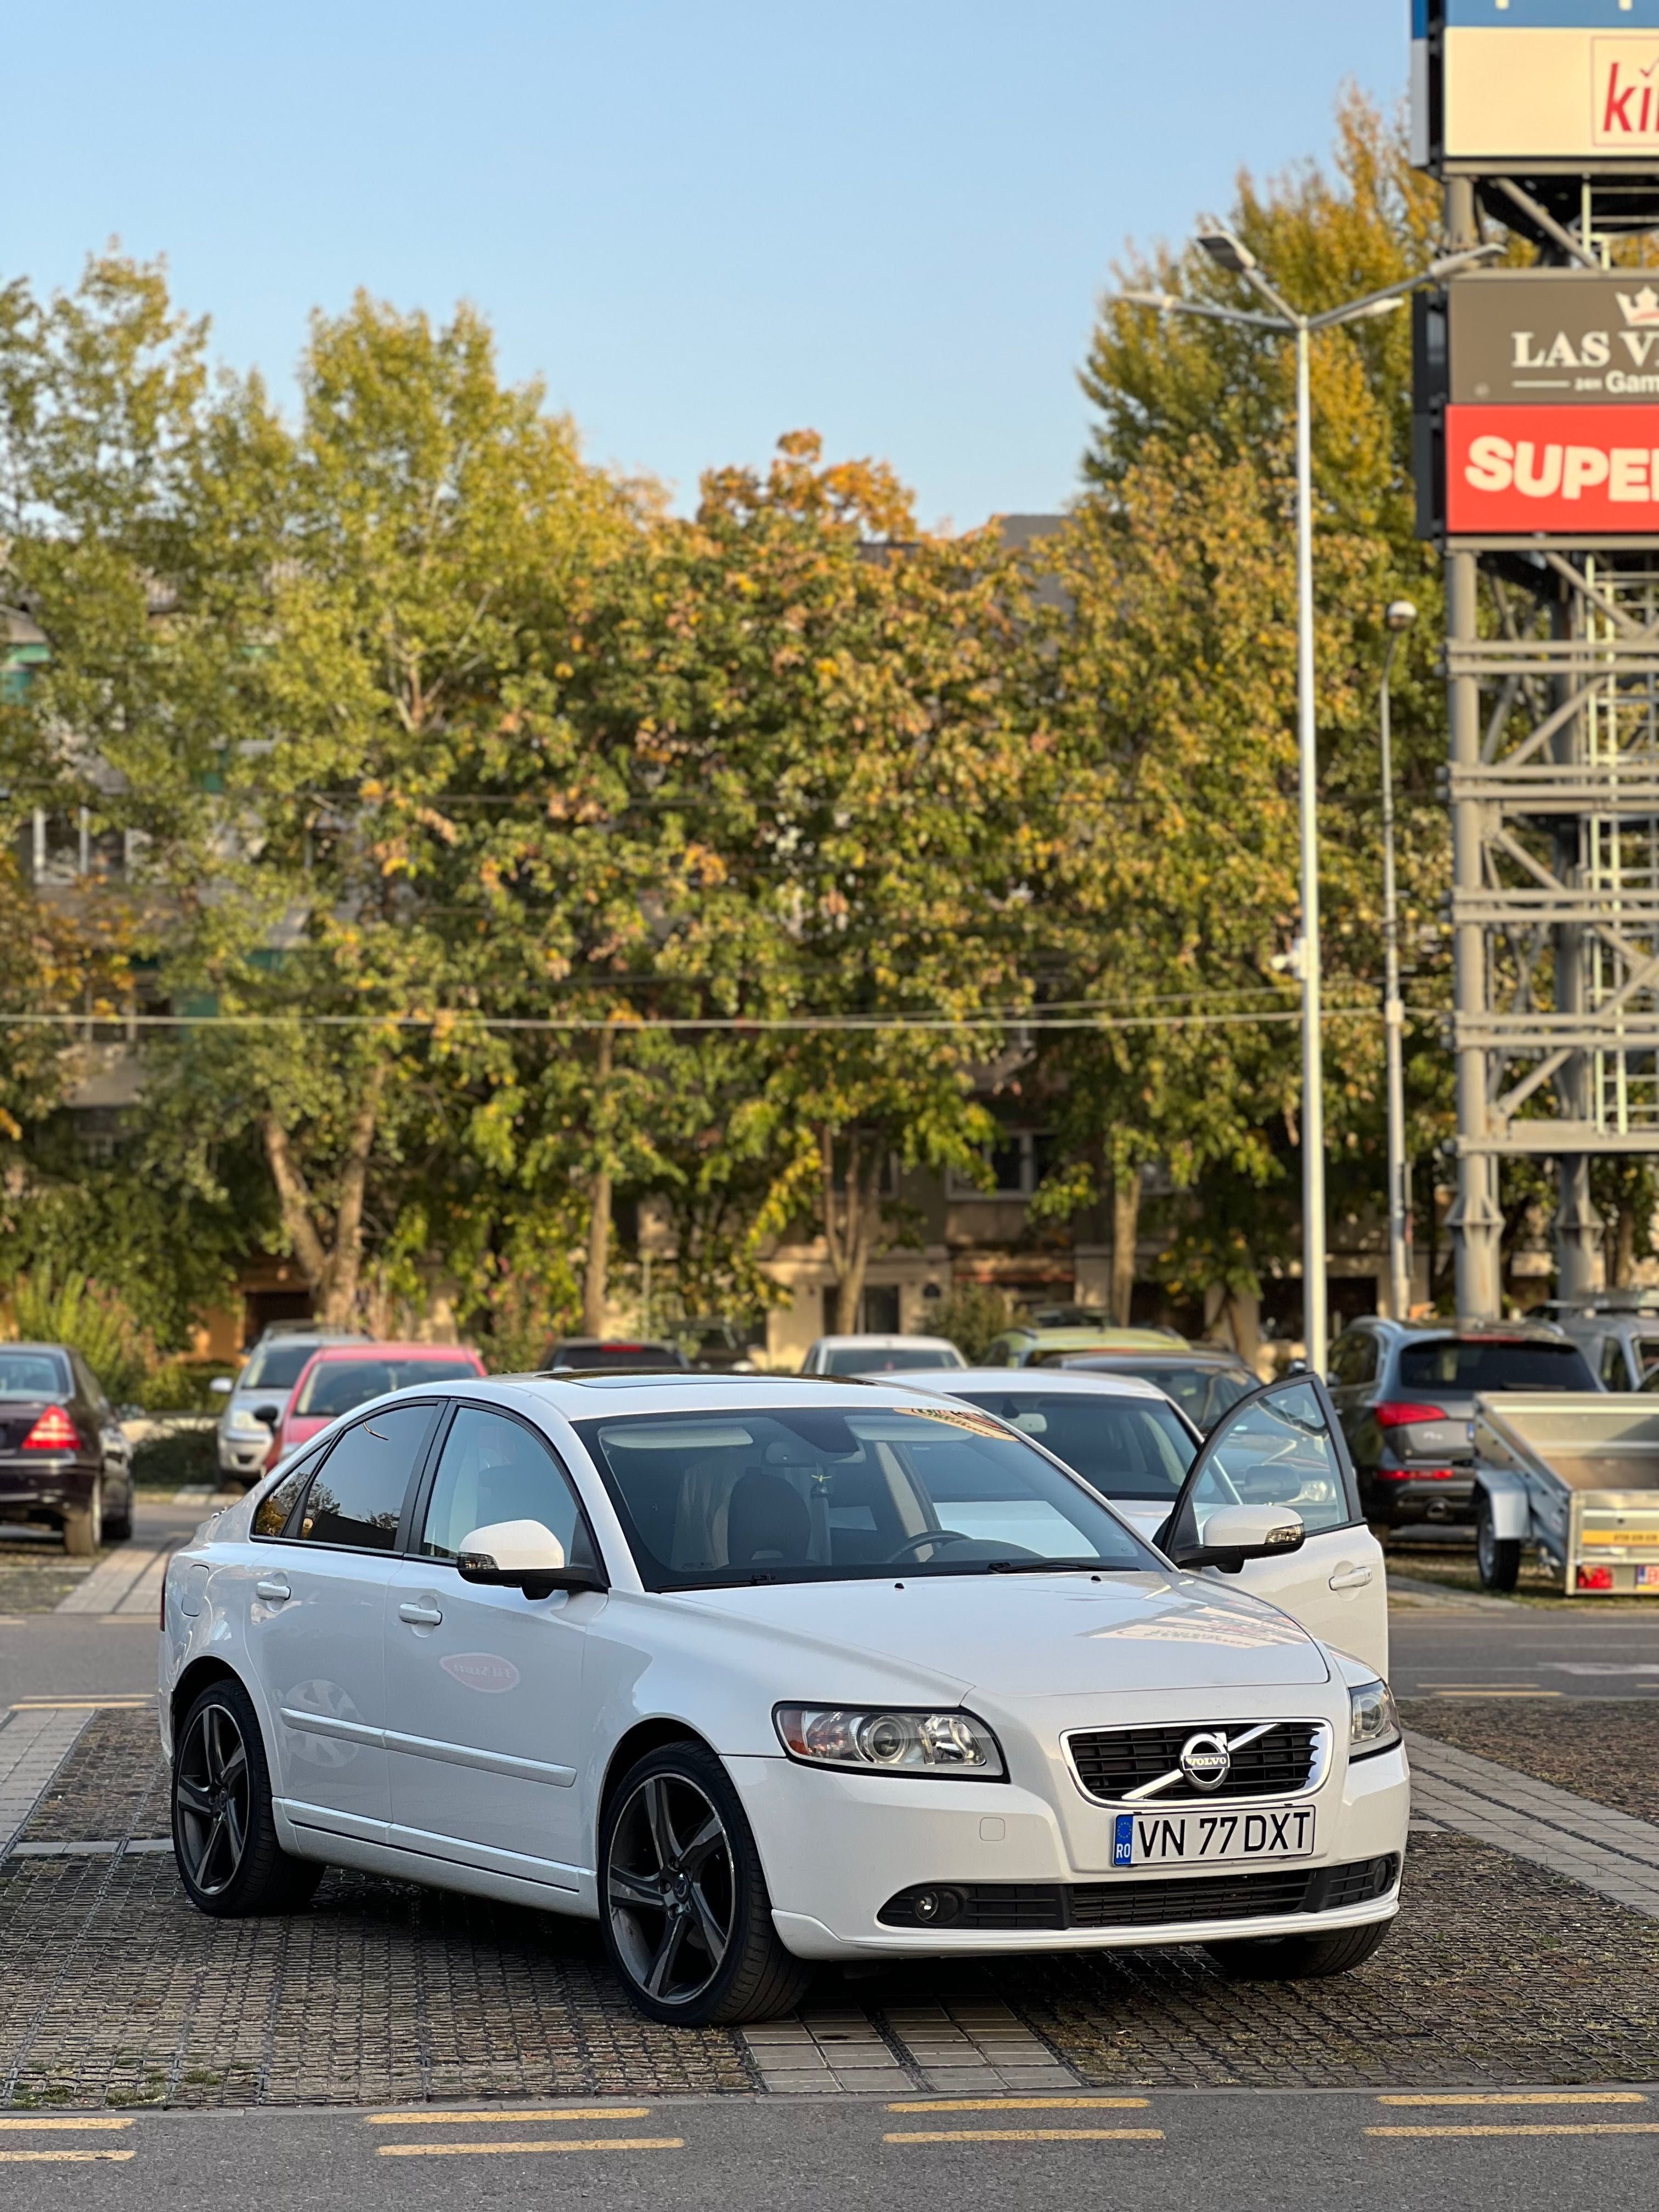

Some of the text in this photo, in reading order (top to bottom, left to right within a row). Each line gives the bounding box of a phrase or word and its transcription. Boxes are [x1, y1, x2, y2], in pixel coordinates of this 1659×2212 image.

[1604, 62, 1659, 132] ki
[1511, 331, 1659, 368] LAS V
[1464, 435, 1659, 502] SUPE
[1185, 1757, 1227, 1766] VOLVO
[1116, 1843, 1131, 1858] RO
[1138, 1812, 1310, 1858] VN 77 DXT
